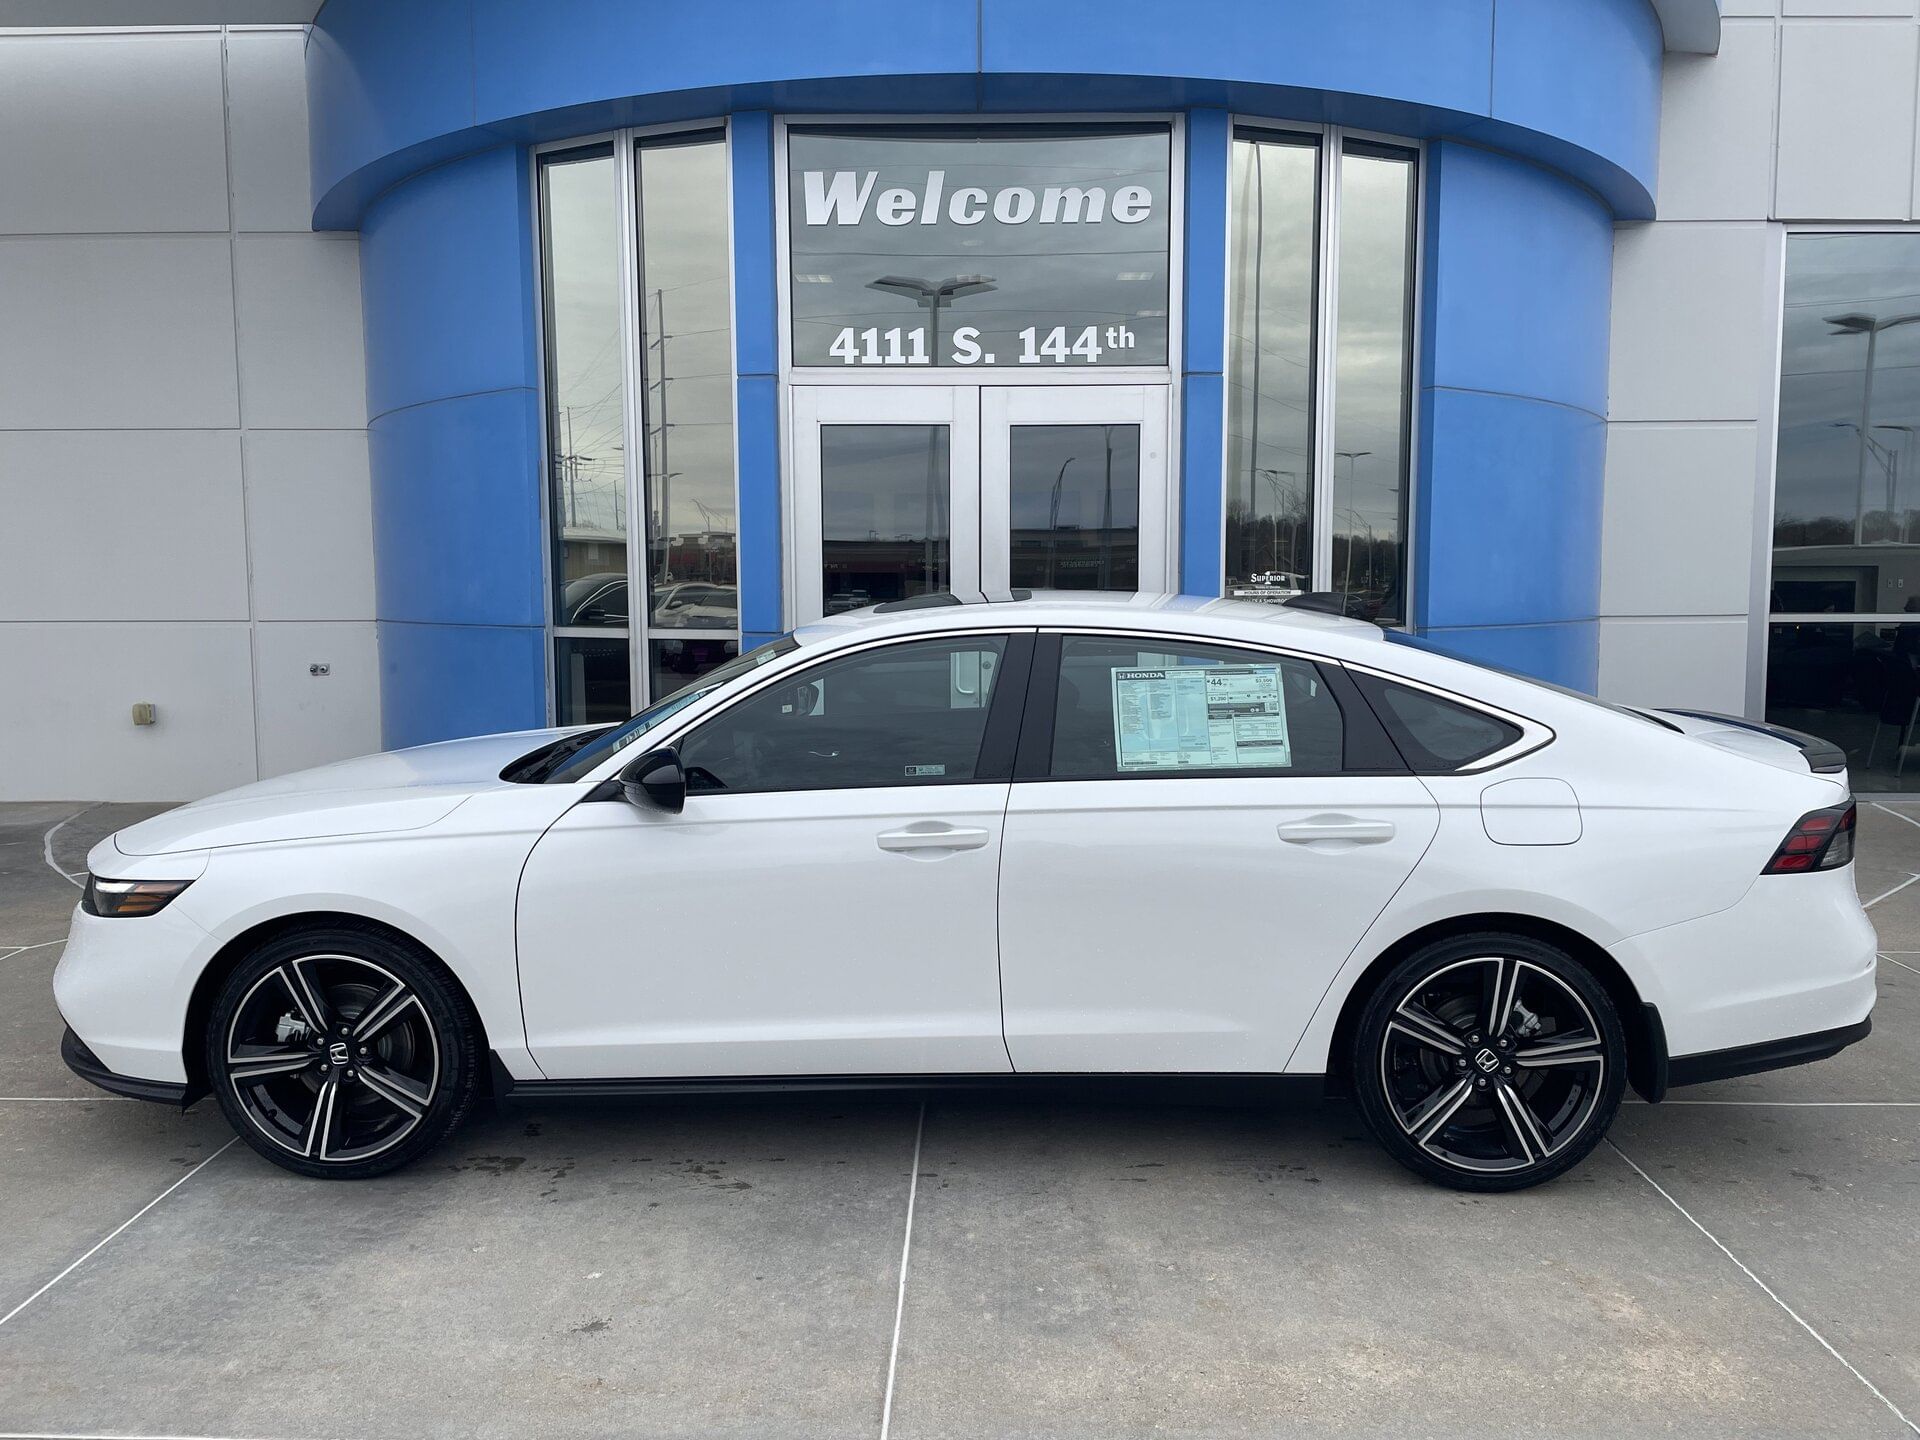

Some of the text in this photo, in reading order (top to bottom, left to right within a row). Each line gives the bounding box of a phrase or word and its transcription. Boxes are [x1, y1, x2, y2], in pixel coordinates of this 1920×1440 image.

[803, 170, 1152, 226] Welcome
[829, 324, 1136, 364] 4111 S. 144th
